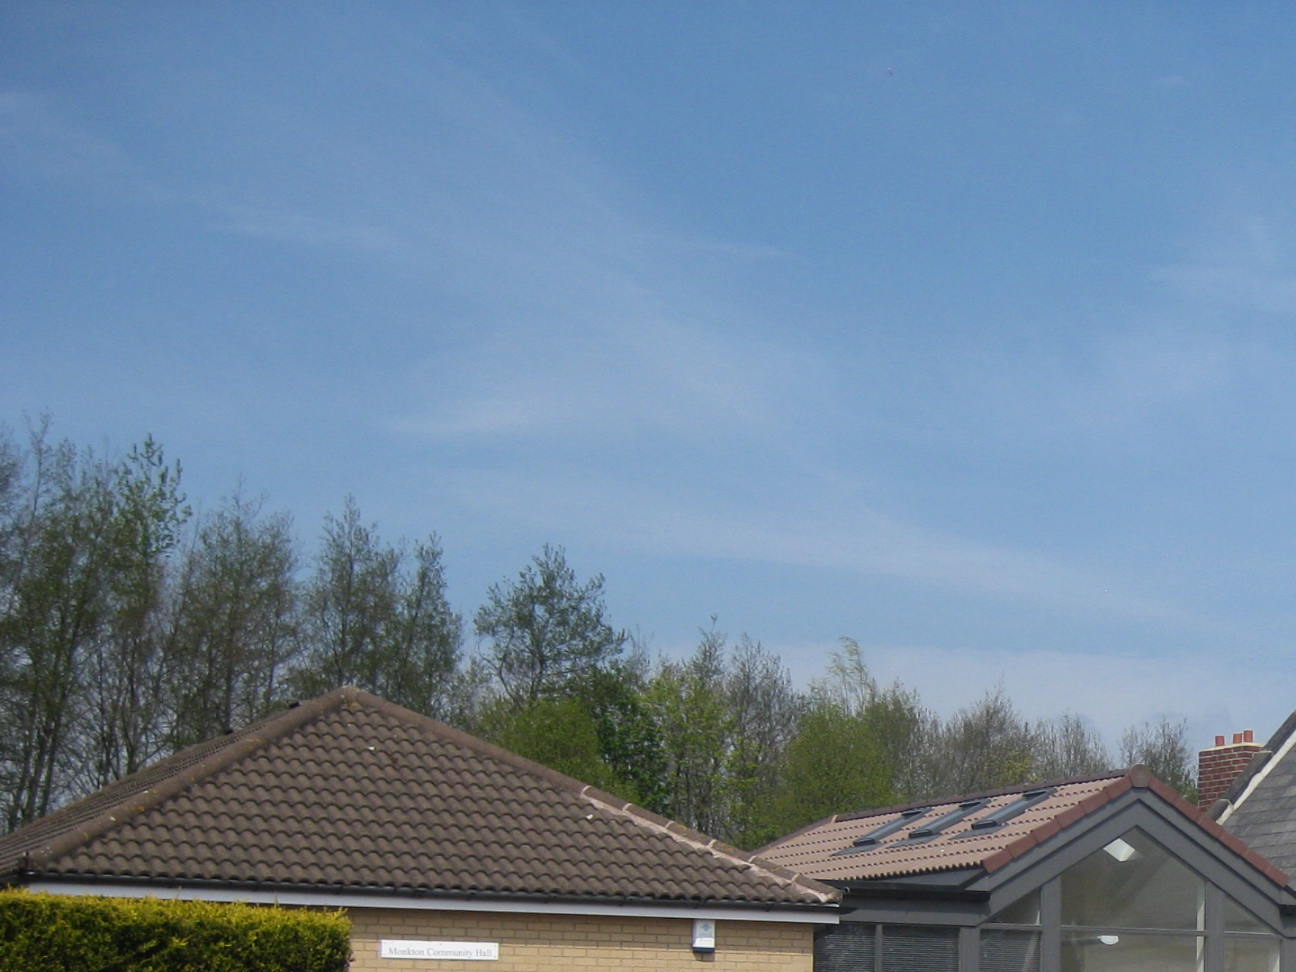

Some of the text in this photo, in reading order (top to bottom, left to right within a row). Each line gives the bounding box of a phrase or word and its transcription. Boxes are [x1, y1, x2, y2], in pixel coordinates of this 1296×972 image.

[388, 947, 492, 958] Monkton Community Hall
